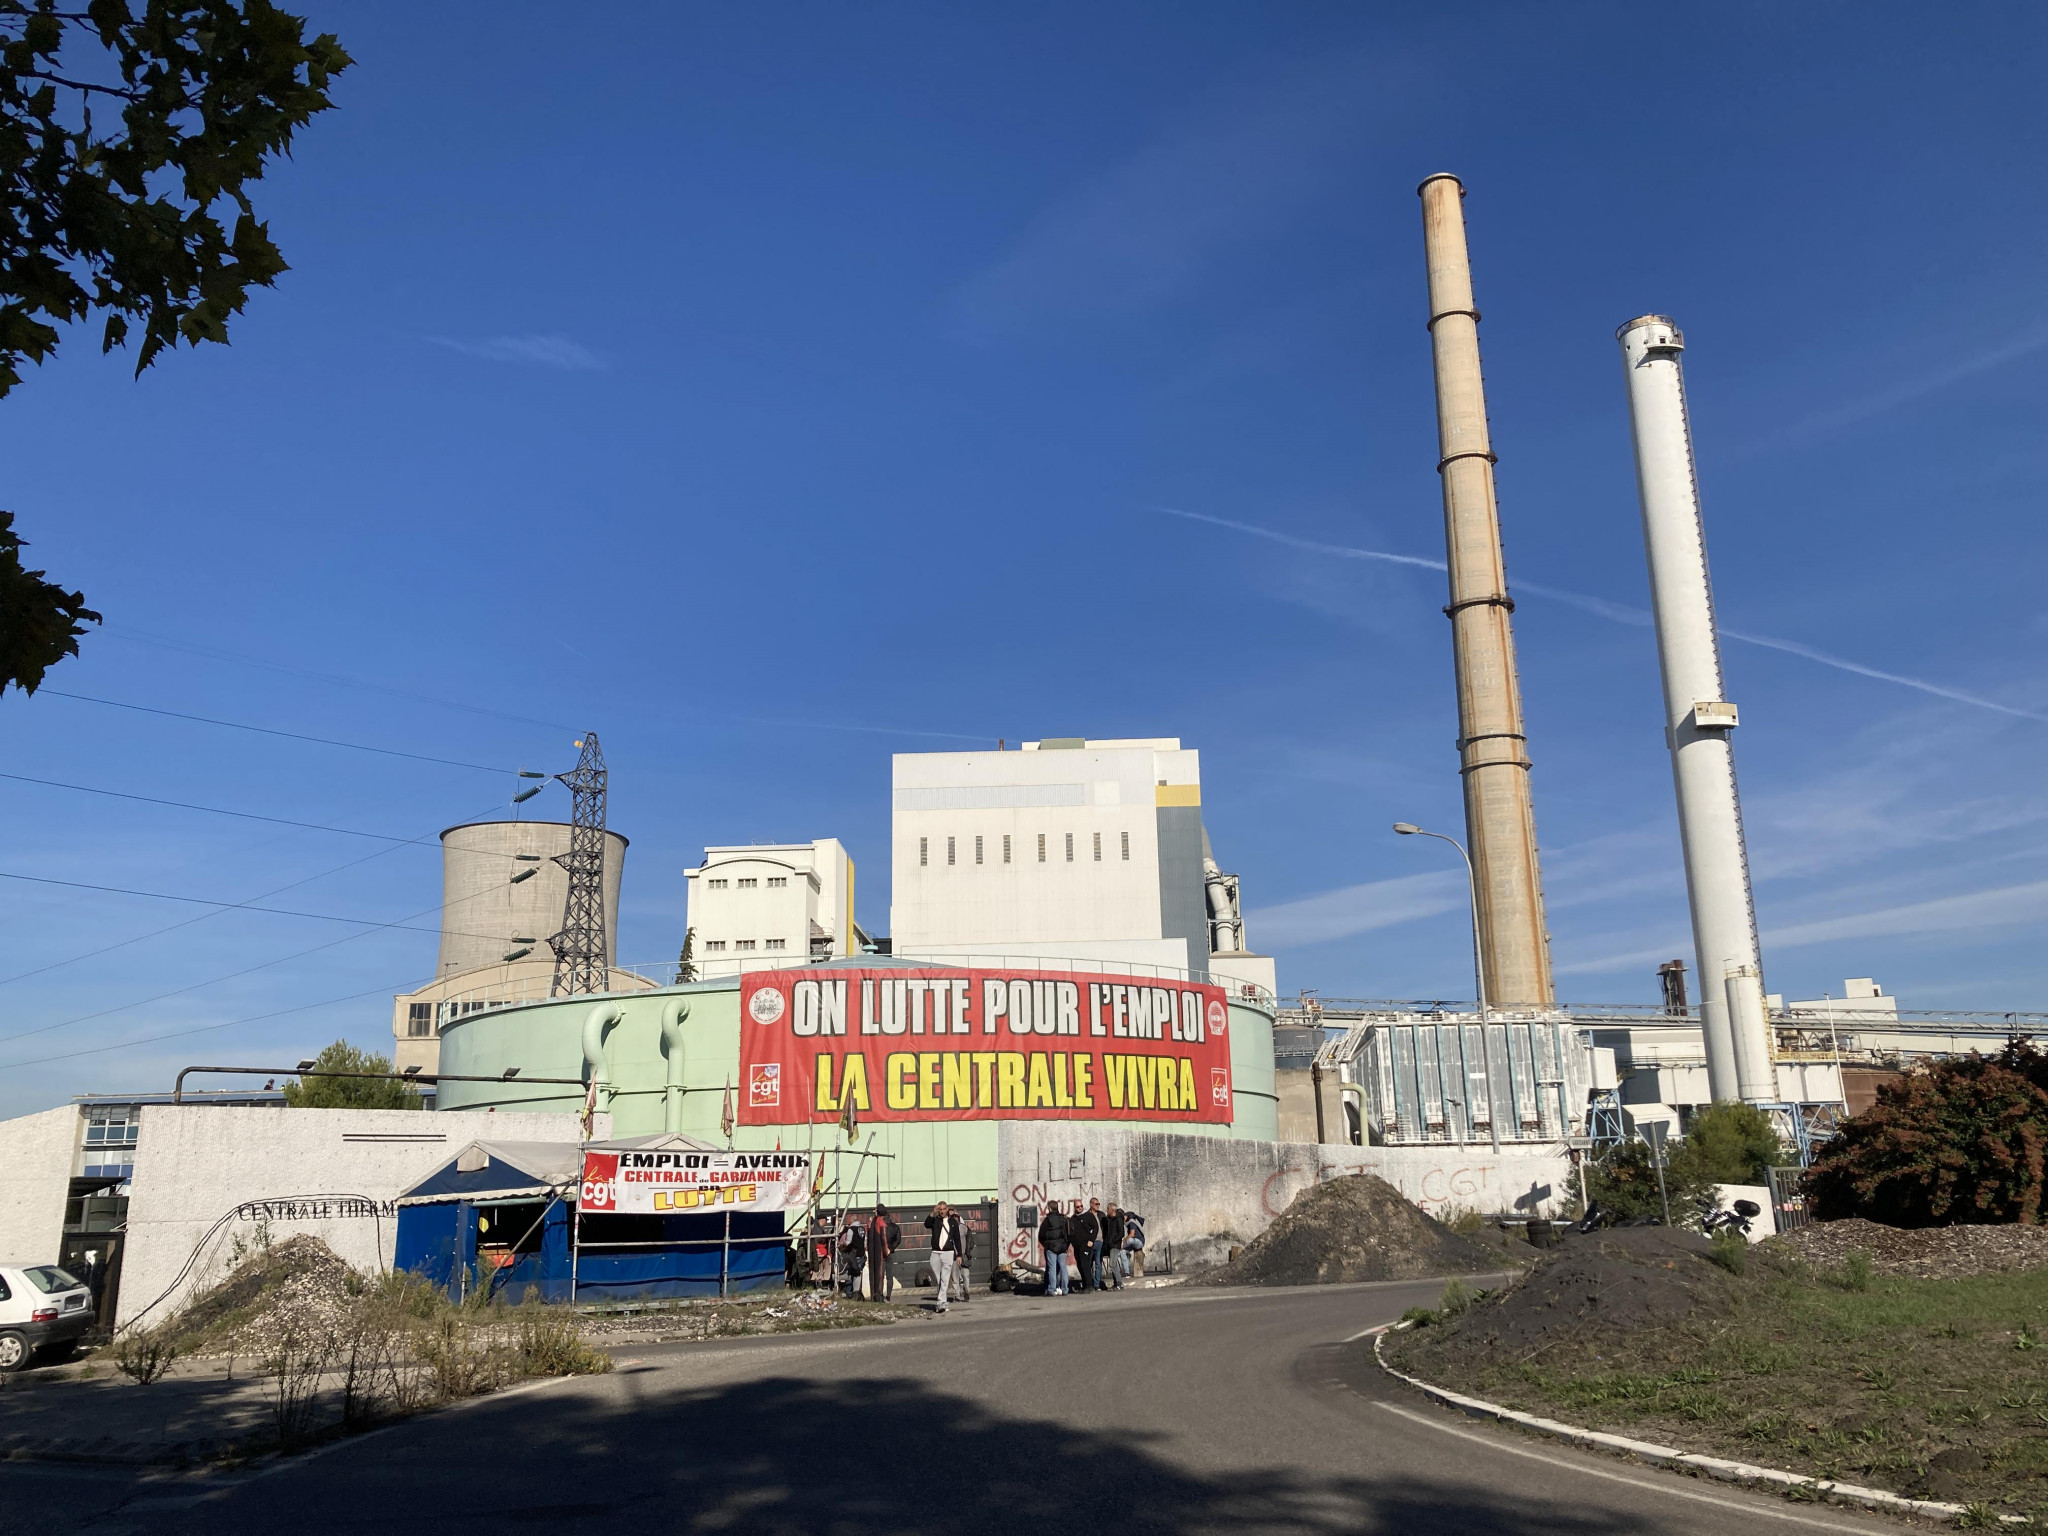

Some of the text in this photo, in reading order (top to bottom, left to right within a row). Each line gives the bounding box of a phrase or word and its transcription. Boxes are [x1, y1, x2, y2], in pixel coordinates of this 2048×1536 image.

[791, 978, 848, 1037] ON
[860, 978, 971, 1038] LUTTE
[983, 978, 1082, 1037] POUR
[1089, 980, 1206, 1044] L'EMPLOI
[752, 1078, 779, 1095] cgt
[814, 1050, 1200, 1112] LA CENTRALE VIVRA
[620, 1153, 710, 1169] EMPLOI
[624, 1171, 698, 1183] CENTRALE
[710, 1171, 782, 1182] GARDANNE
[1422, 1166, 1496, 1202] CGT
[581, 1178, 617, 1205] cgt
[653, 1184, 757, 1211] LUTTE
[1012, 1183, 1047, 1203] ON
[239, 1202, 332, 1221] CENTRALE
